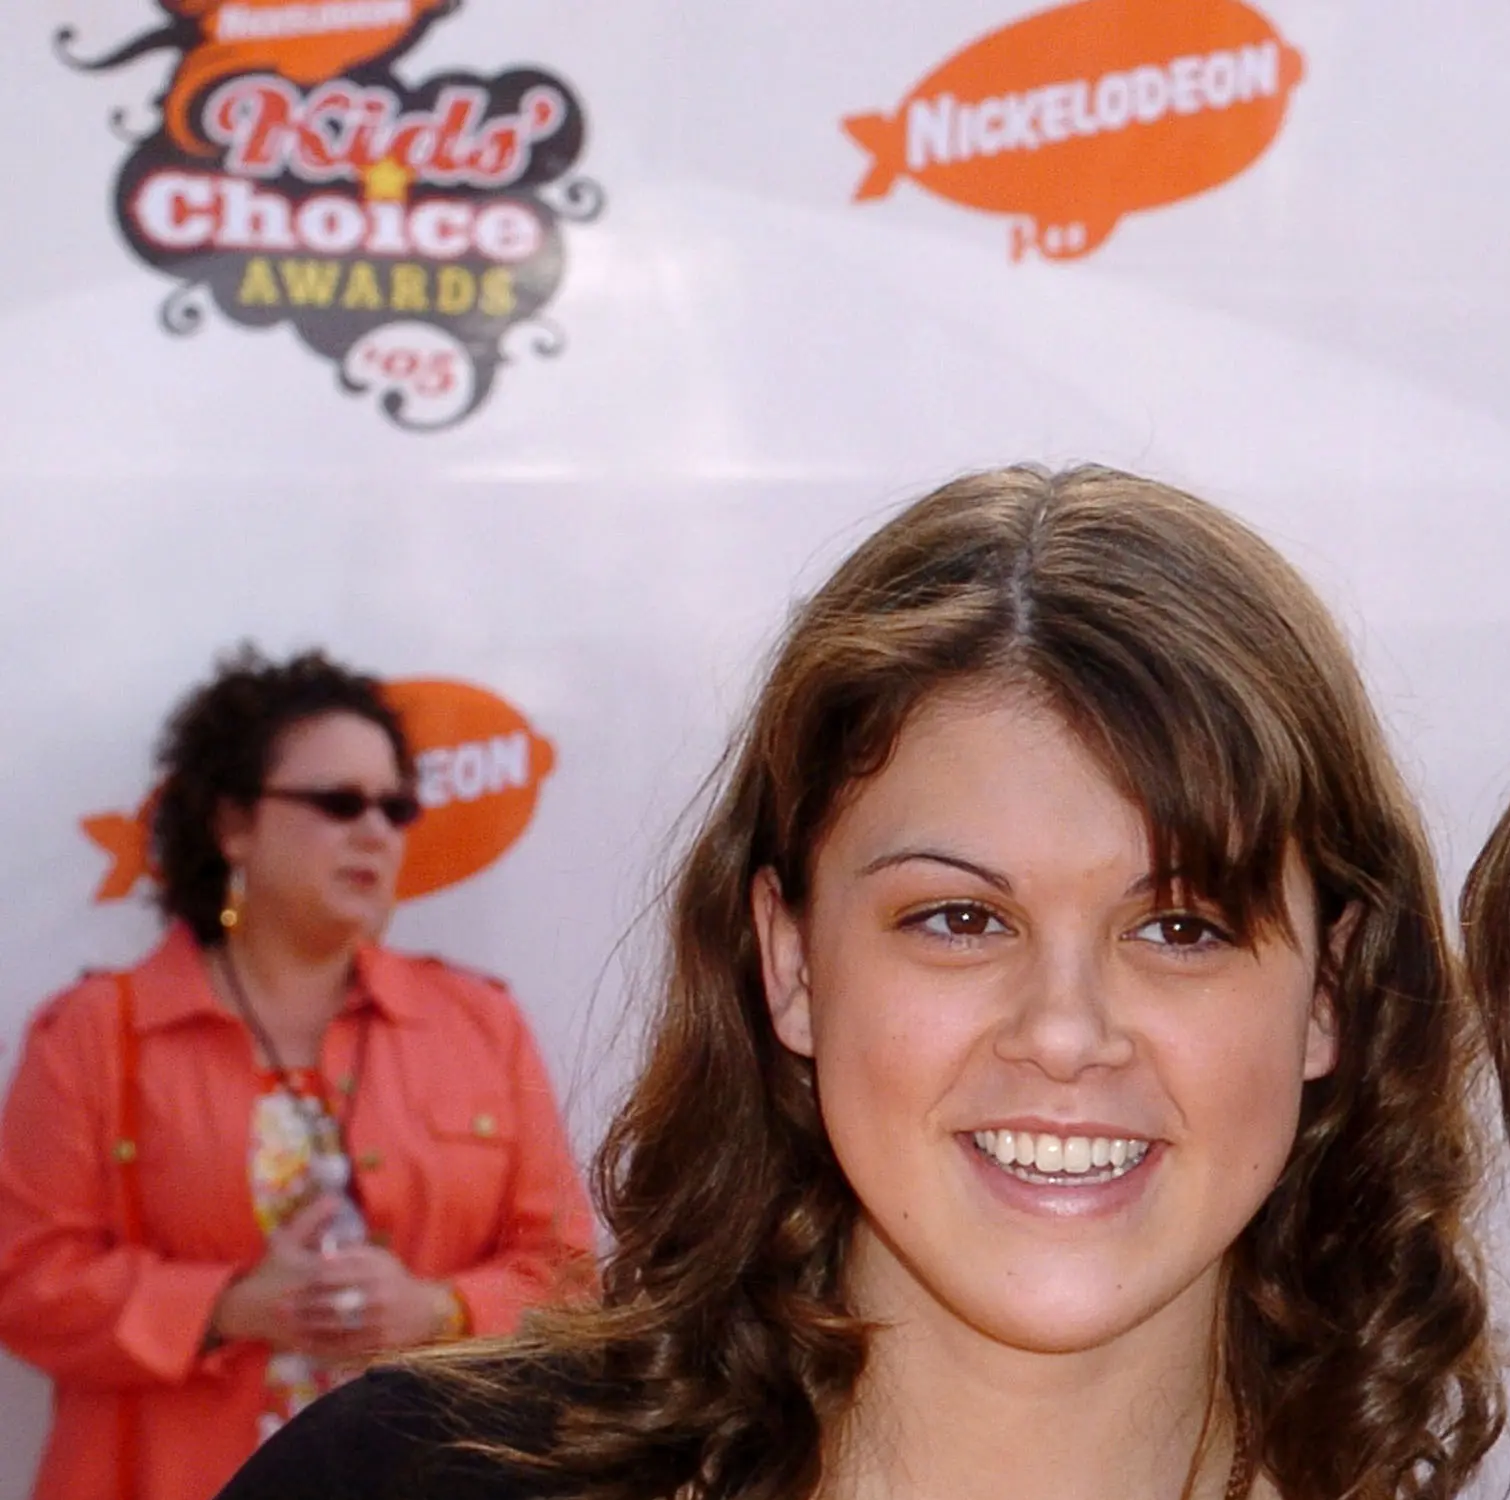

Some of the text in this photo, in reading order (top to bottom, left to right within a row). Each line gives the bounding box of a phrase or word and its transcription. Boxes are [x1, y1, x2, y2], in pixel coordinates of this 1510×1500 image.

[208, 78, 562, 183] Kids'
[907, 40, 1281, 168] NICKELODEON
[137, 172, 541, 258] Choice
[240, 258, 517, 316] AWARDS
